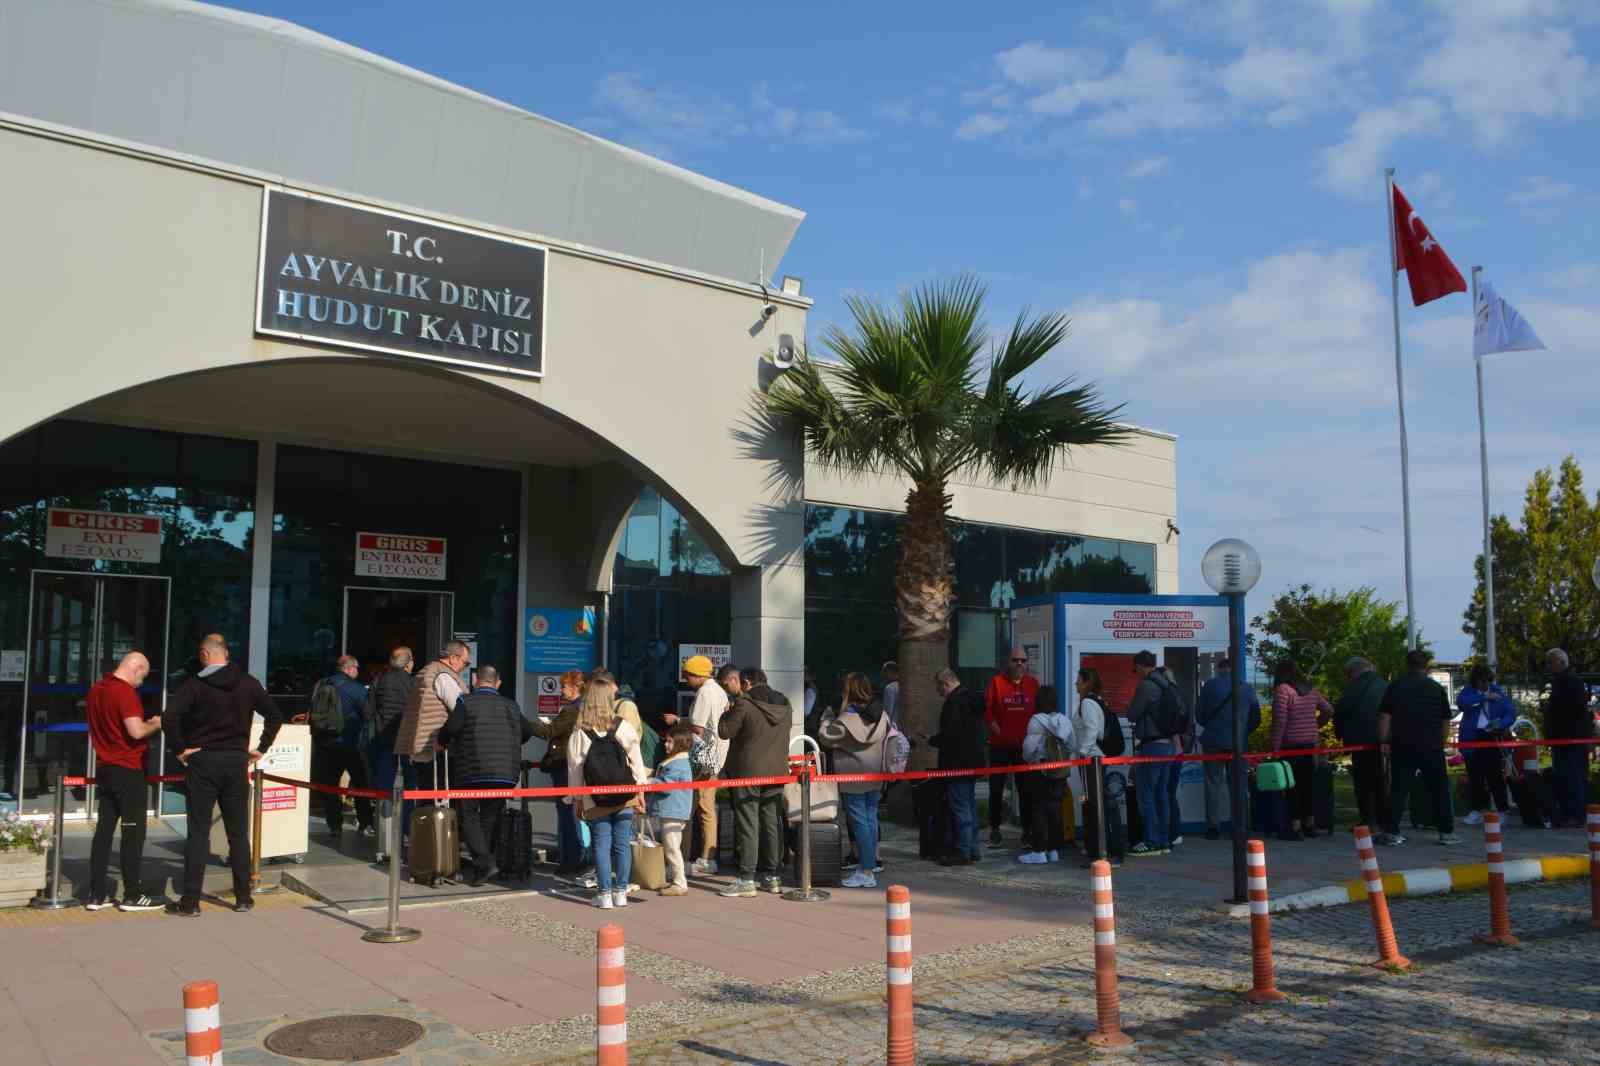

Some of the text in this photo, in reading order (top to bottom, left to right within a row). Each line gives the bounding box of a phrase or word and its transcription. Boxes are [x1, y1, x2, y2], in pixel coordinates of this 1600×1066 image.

[386, 229, 443, 263] T.C.
[280, 252, 532, 320] AYVALIK DENİZ
[276, 289, 533, 357] HUDUT KAPISI
[83, 531, 128, 544] EXIT
[62, 544, 144, 560] ΕΞΟΔΟΣ
[361, 551, 441, 566] ENTRANCE
[368, 563, 439, 577] ΕΙΣΟΔΟΣ
